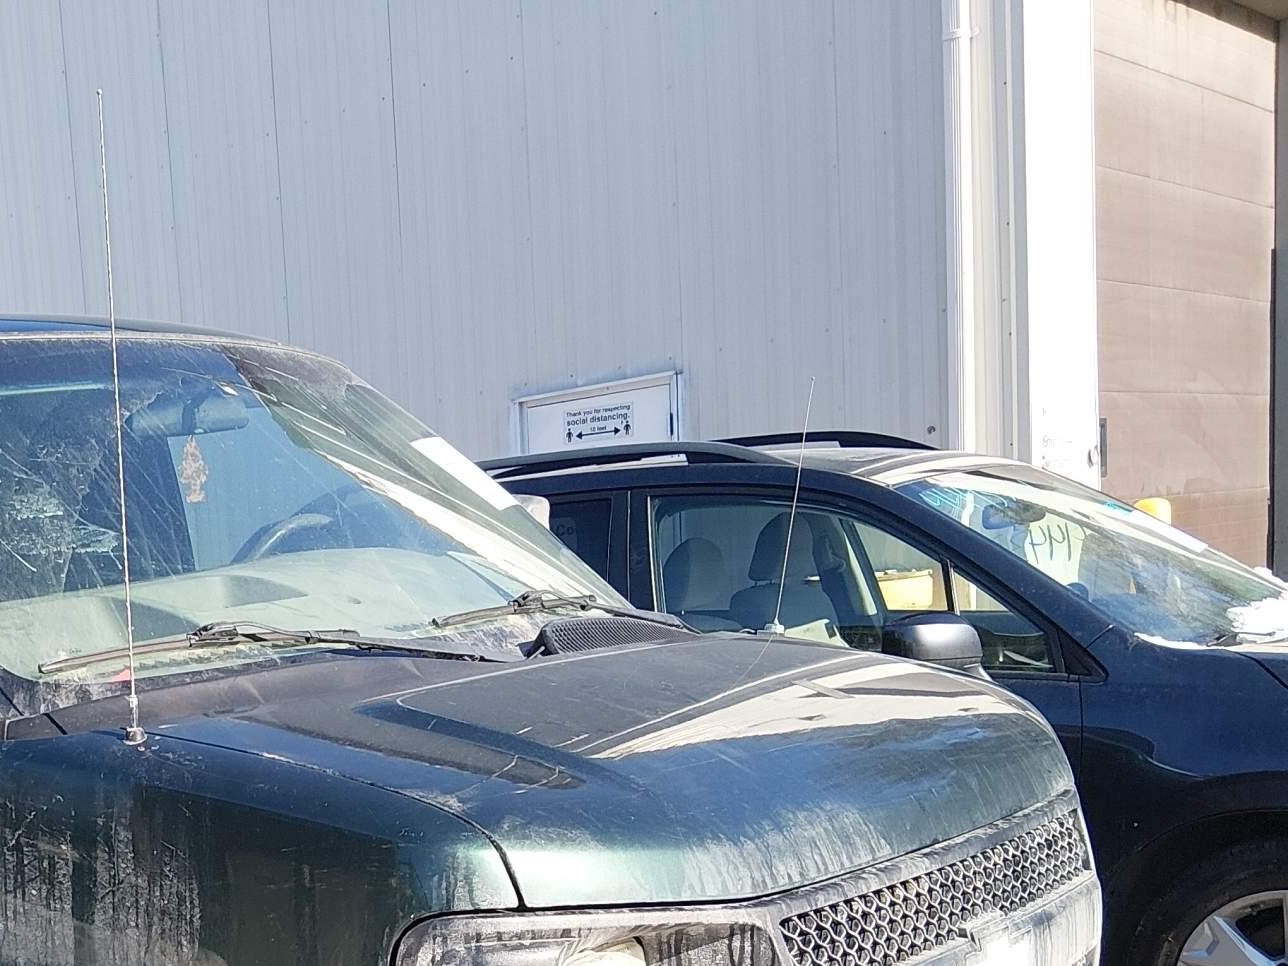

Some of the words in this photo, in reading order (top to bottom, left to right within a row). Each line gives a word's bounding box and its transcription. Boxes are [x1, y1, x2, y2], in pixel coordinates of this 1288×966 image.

[602, 404, 631, 412] respecting
[567, 417, 588, 427] social
[589, 412, 631, 423] distancing.
